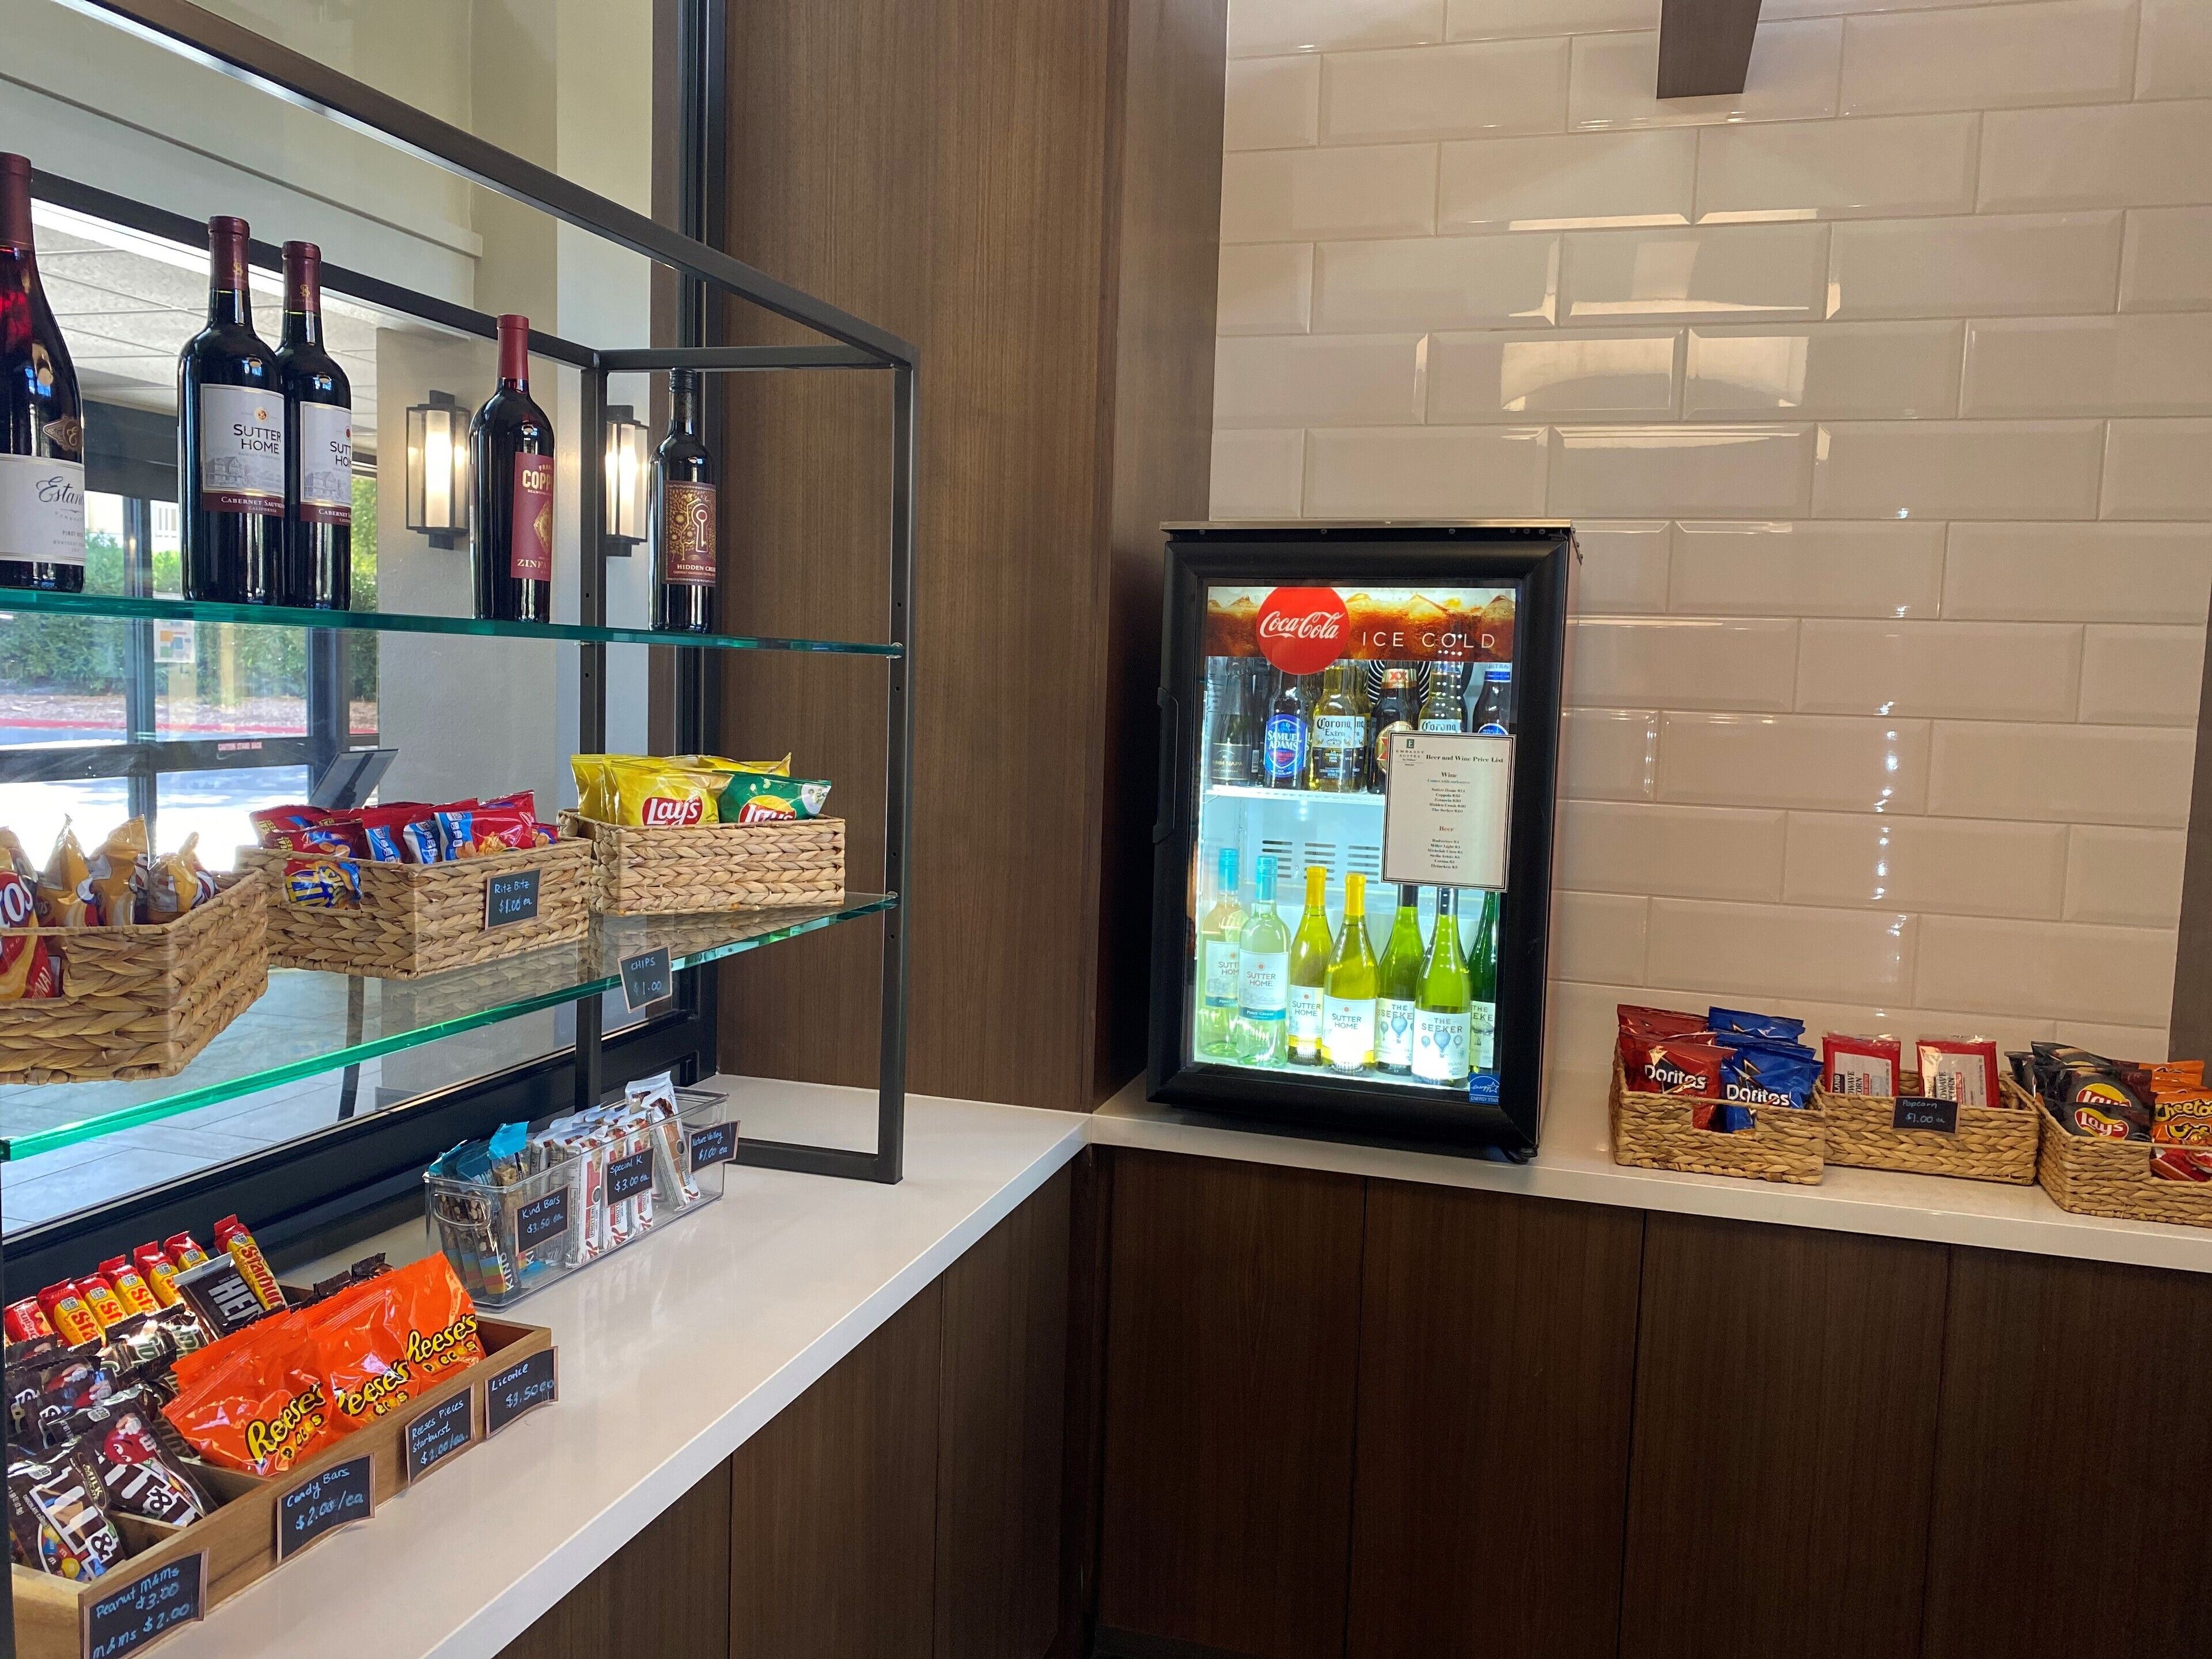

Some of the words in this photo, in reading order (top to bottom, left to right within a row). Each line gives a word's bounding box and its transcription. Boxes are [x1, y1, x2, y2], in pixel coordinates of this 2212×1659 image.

[233, 424, 281, 443] SUTTER
[241, 438, 280, 455] HOME
[329, 441, 351, 455] SUTT
[522, 469, 553, 490] COPP
[36, 476, 84, 505] Estan
[221, 496, 262, 505] CABERNET
[319, 509, 349, 518] CABERNET
[1259, 611, 1346, 639] Coca-Cola
[1362, 631, 1404, 647] ICE
[1422, 632, 1495, 649] COLD
[1317, 718, 1353, 731] Corona
[1325, 729, 1344, 737] Extra
[1422, 721, 1457, 732] Corona
[1267, 730, 1302, 743] SAMUEL
[1268, 740, 1300, 751] ADAMS
[494, 882, 512, 894] Ritz
[513, 878, 530, 891] Bitz
[498, 896, 521, 914] $1.00
[631, 957, 656, 970] CHIPS
[1247, 971, 1276, 980] SUTTER
[633, 980, 662, 995] $1.00
[1291, 1001, 1321, 1010] SUTTER
[1332, 1013, 1362, 1022] SUTTER
[1381, 1010, 1413, 1020] SEEKE
[1421, 1023, 1463, 1033] SEEKER
[1645, 1065, 1707, 1090] Doritos
[1938, 1071, 1946, 1099] OWAVE
[1726, 1084, 1790, 1107] Doritos
[1903, 1099, 1937, 1109] Popcorn
[2155, 1099, 2212, 1122] Cheeto
[609, 1158, 633, 1176] Special
[614, 1176, 639, 1193] $3.00
[522, 1202, 541, 1220] Kind
[543, 1195, 560, 1209] Bars
[240, 1247, 284, 1305] Starbur
[498, 1252, 514, 1291] KIND
[406, 1313, 478, 1364] Reese's
[491, 1363, 529, 1392] Licorice
[411, 1418, 436, 1440] Reeses
[85, 1464, 103, 1497] MILK
[286, 1481, 321, 1508] Candy
[323, 1467, 350, 1484] Bars
[96, 1586, 137, 1619] Peanut
[135, 1581, 180, 1611] $3.00
[143, 1603, 190, 1633] $2.00
